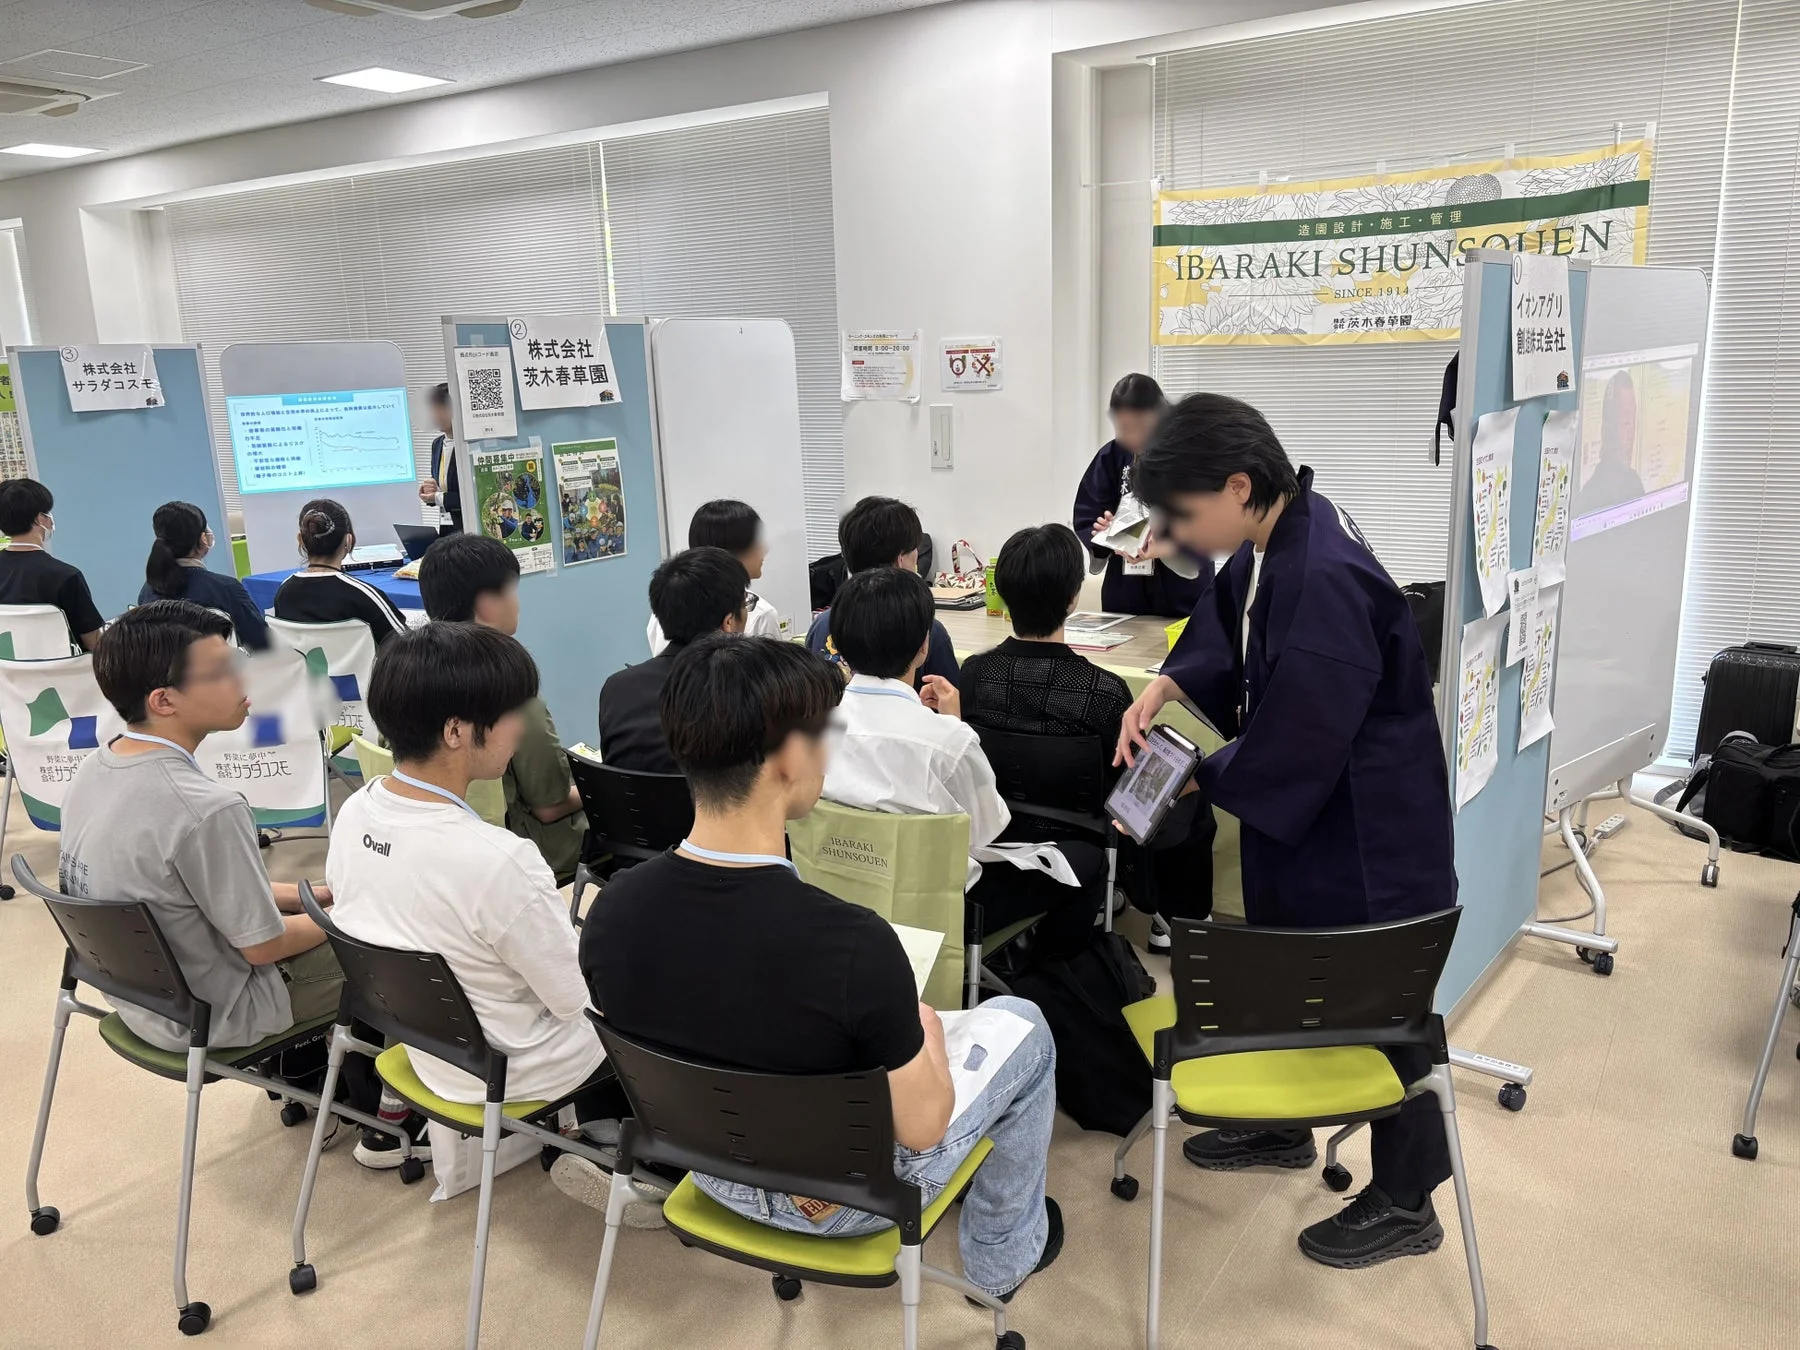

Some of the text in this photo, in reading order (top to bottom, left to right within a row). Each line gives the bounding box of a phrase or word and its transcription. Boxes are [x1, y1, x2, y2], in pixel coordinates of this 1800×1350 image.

[1298, 210, 1463, 238] 造園設計・施工・管理
[1175, 249, 1322, 281] IBARAKI
[1334, 286, 1409, 299] SINCE 1914
[1516, 292, 1563, 319] イオンアグリ
[527, 338, 594, 361] 株式会社
[1516, 327, 1567, 355] 創造株式会社
[82, 361, 137, 376] 株式会社
[523, 363, 609, 388] 茨木春草園
[71, 377, 153, 394] サラダコスモ
[477, 453, 515, 466] 仲間募集中
[362, 833, 391, 858] Ovall
[830, 836, 874, 853] IBARAKI
[822, 846, 888, 868] SHUNSOUEN
